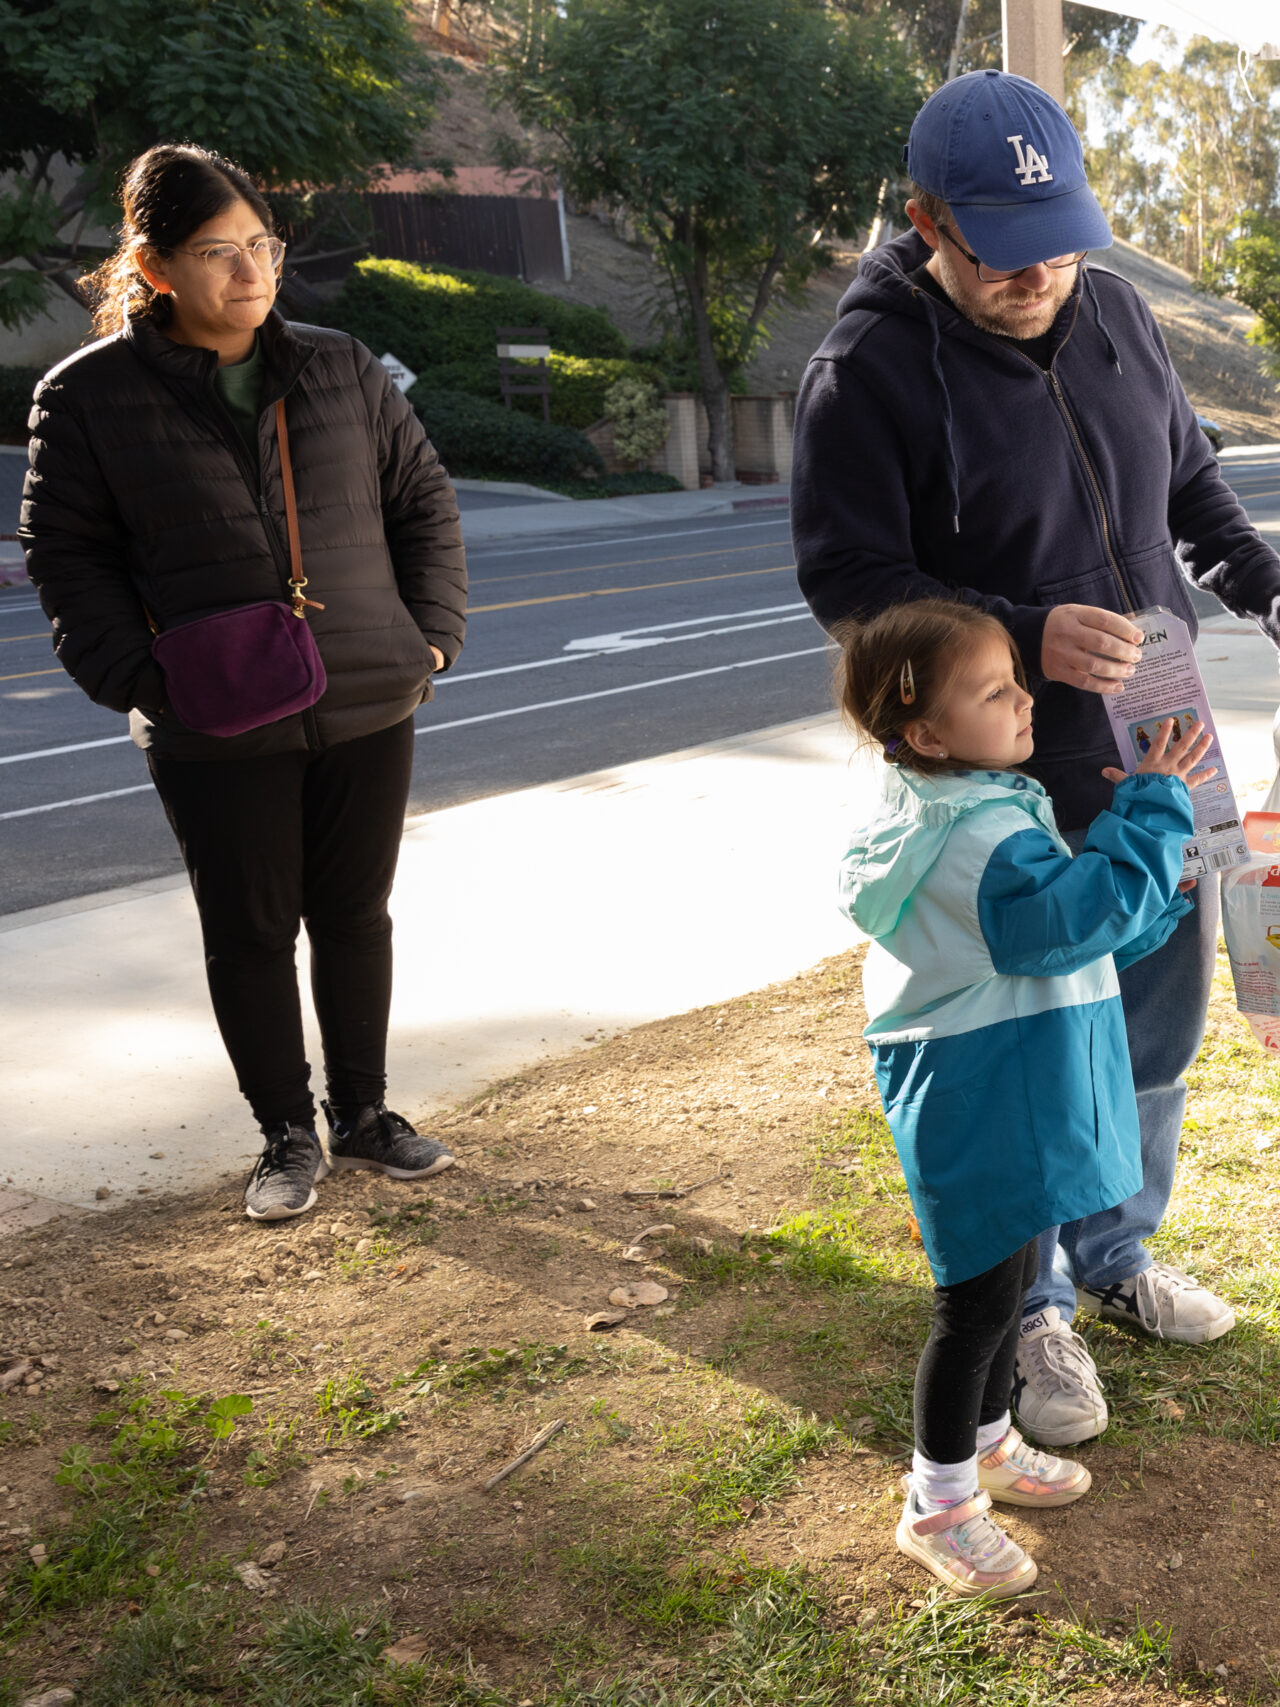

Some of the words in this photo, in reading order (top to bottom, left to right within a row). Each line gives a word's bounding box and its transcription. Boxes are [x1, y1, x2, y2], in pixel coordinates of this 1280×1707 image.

[1007, 135, 1053, 185] LA
[1138, 628, 1169, 648] ZEN
[1021, 1317, 1043, 1333] asics
